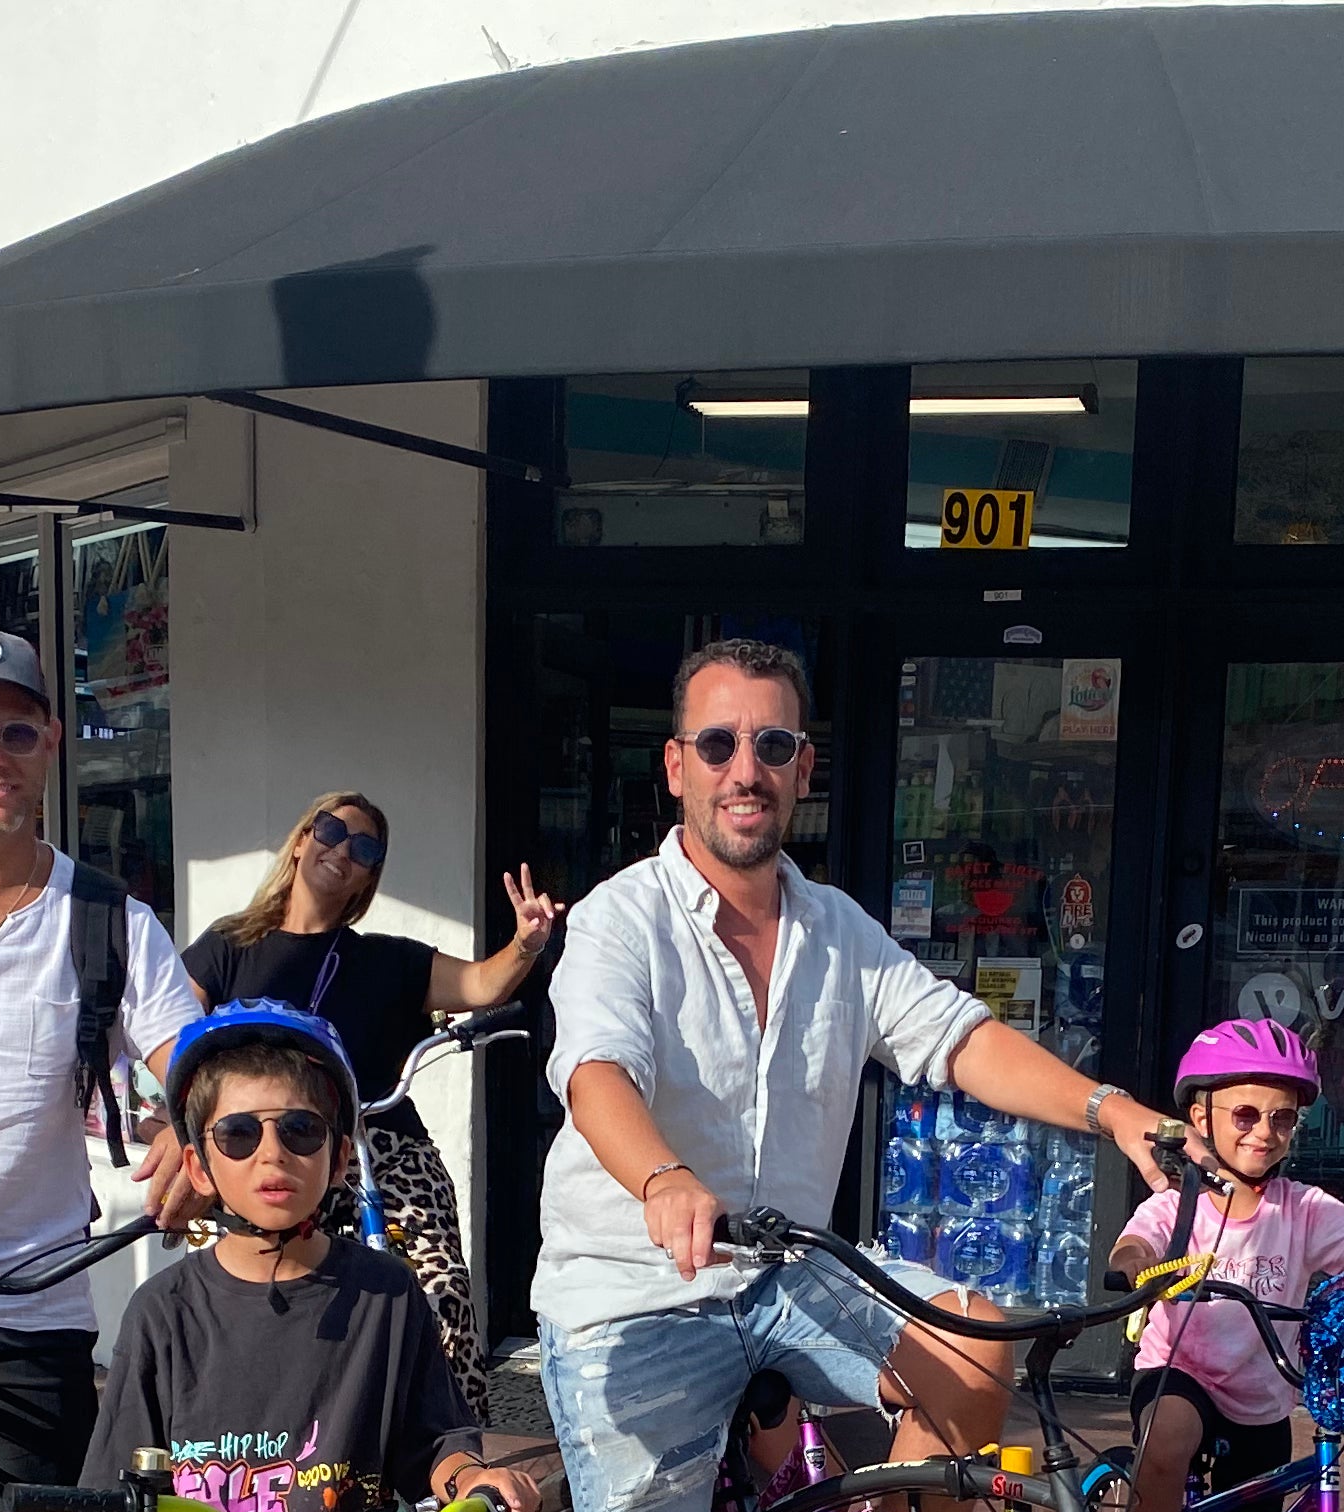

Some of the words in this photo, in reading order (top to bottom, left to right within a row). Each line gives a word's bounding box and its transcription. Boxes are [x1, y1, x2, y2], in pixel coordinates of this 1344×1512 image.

[943, 491, 1026, 547] 901
[1253, 914, 1279, 927] This
[1245, 930, 1296, 943] Nicotine
[1313, 933, 1329, 943] an
[218, 1431, 253, 1461] HIP
[254, 1430, 289, 1460] HOP
